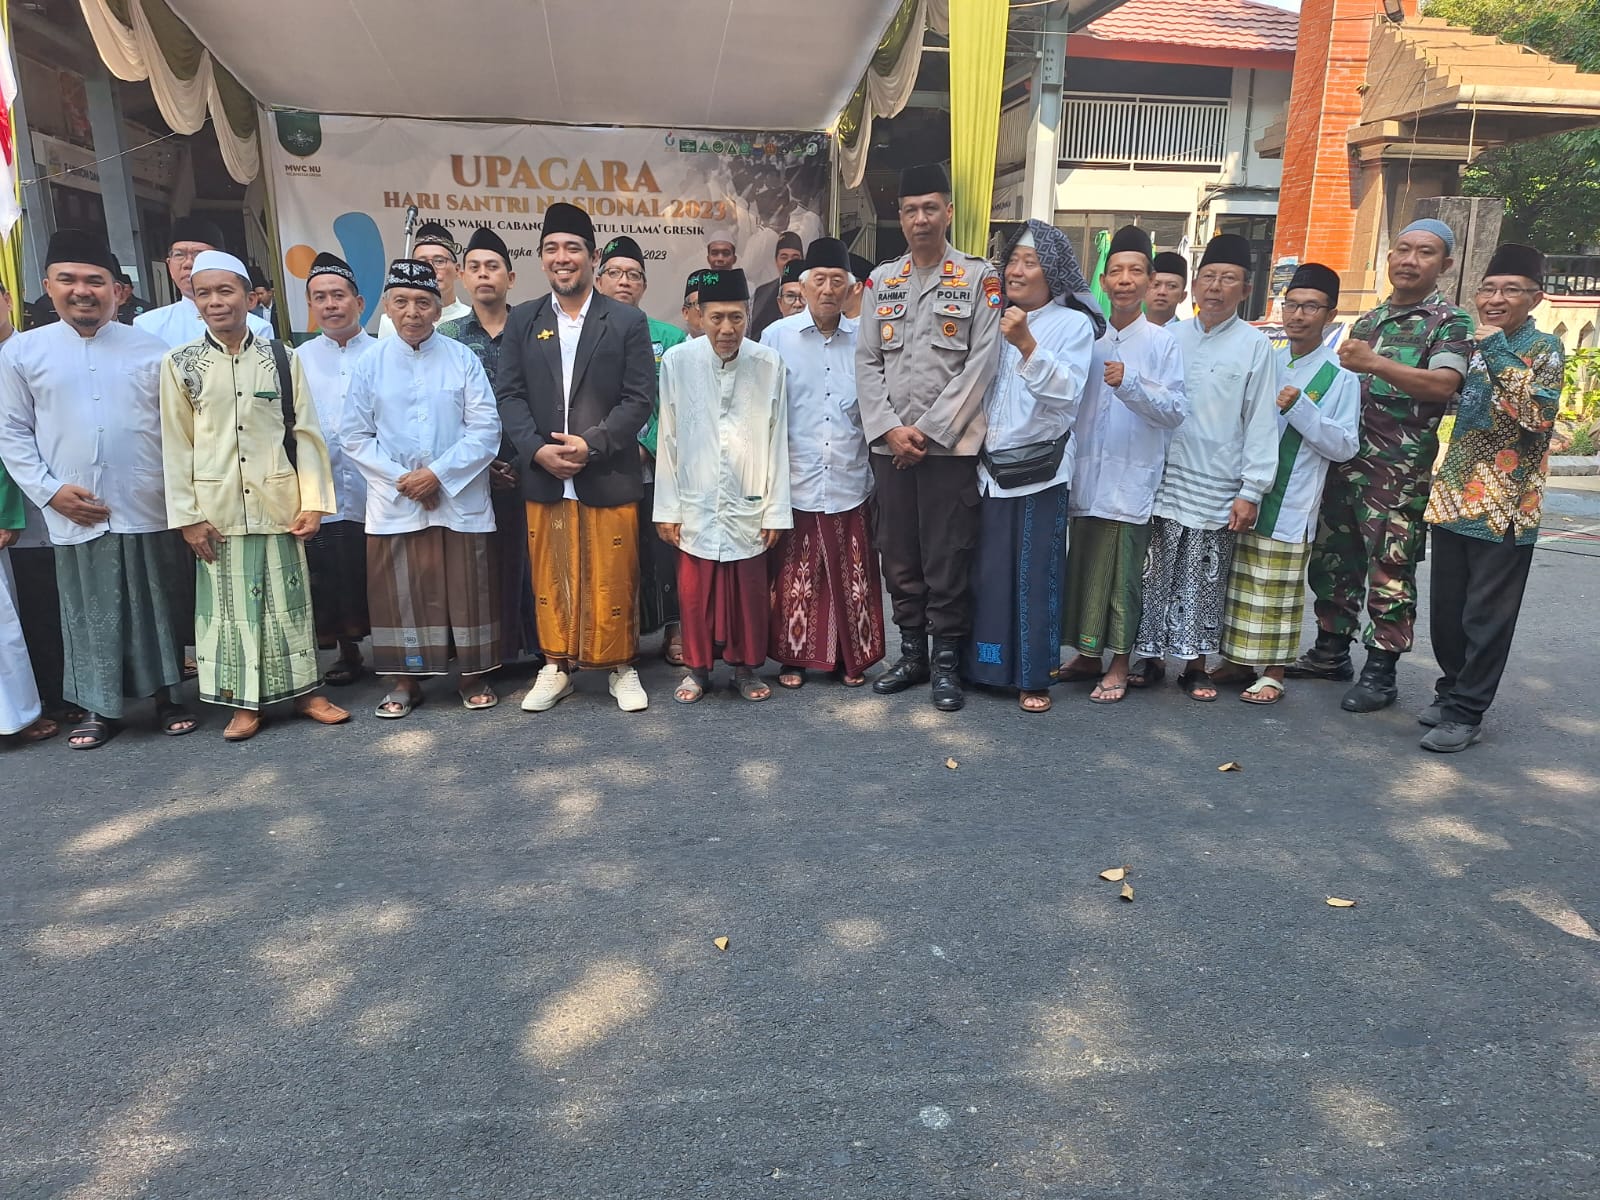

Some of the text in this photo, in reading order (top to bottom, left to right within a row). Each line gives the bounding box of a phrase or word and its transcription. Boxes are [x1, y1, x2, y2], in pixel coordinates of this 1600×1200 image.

[284, 164, 321, 173] MWC NU
[451, 154, 661, 192] UPACARA
[383, 191, 440, 210] HARI
[446, 193, 529, 214] SANTRI
[671, 199, 727, 221] 2023
[457, 218, 496, 230] WAKIL
[663, 225, 705, 236] GRESIK
[643, 249, 667, 260] 2023
[878, 291, 907, 301] RAHMAT
[937, 290, 970, 300] POLRI
